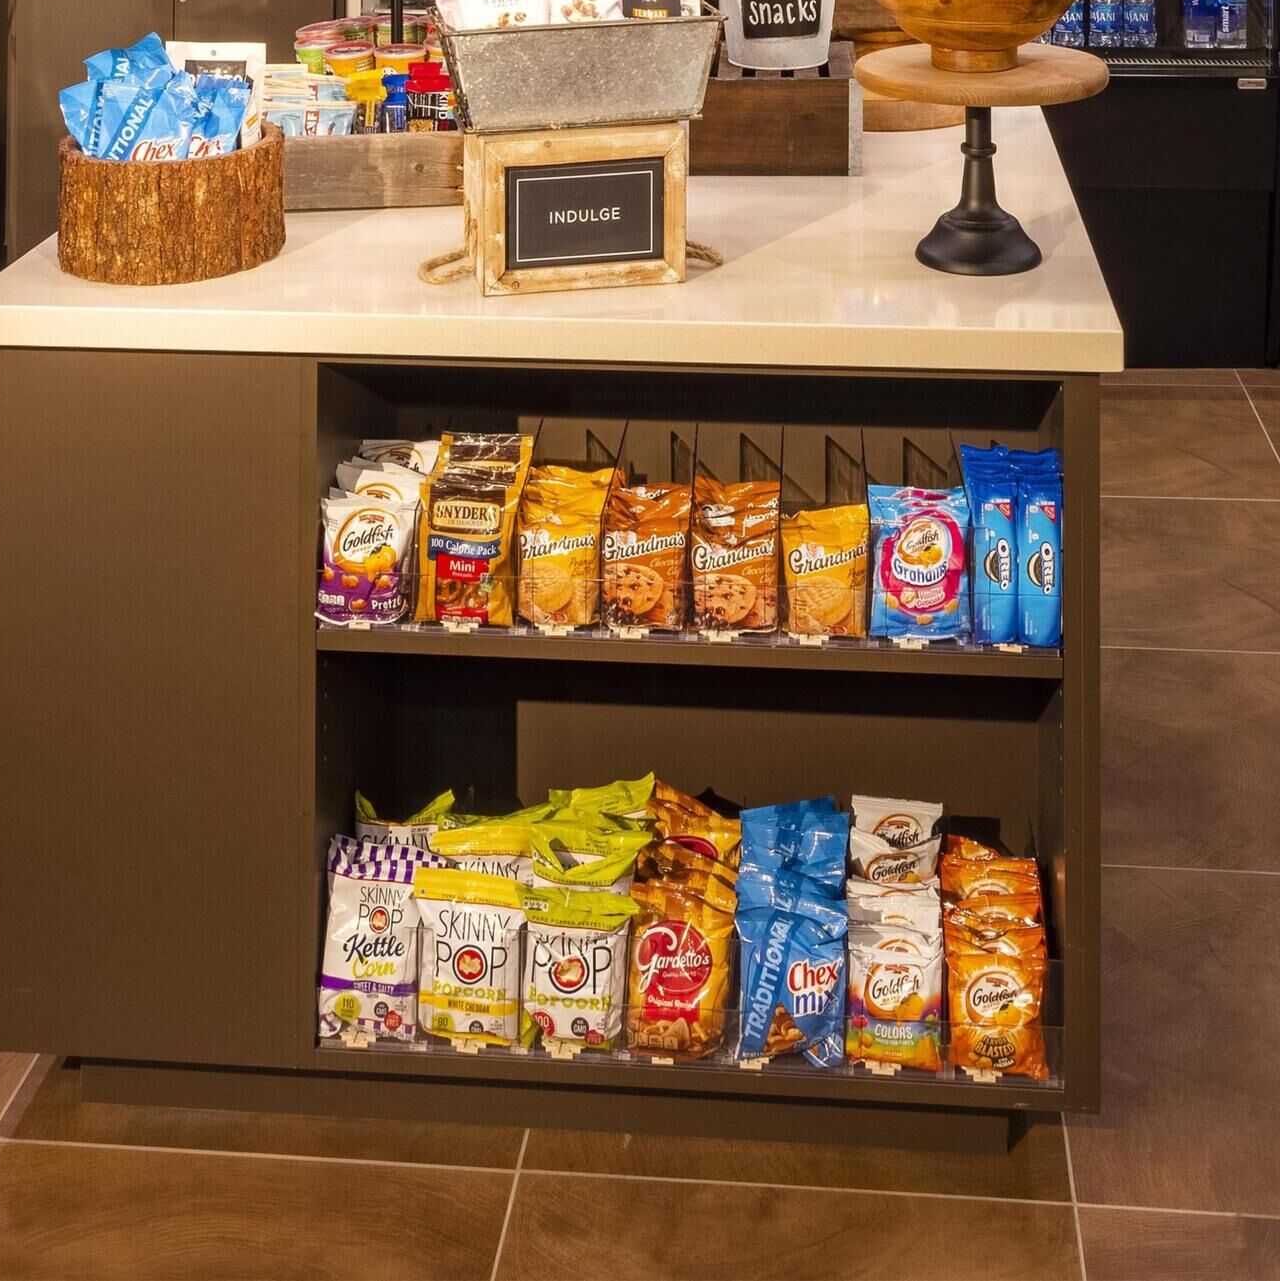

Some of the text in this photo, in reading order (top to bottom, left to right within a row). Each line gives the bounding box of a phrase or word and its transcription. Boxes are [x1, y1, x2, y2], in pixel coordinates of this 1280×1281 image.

[1221, 5, 1230, 33] smart
[439, 93, 449, 120] KIND
[131, 140, 175, 161] Chex
[549, 207, 621, 224] INDULGE
[342, 524, 395, 552] Goldfish
[430, 538, 444, 548] 100
[477, 544, 497, 556] Pack
[604, 531, 686, 561] Grandma's
[449, 560, 476, 572] Mini
[692, 539, 775, 571] Grandma's
[997, 538, 1010, 591] OREO
[1040, 541, 1054, 595] OREO
[871, 859, 918, 881] Goldfish
[360, 884, 406, 910] SKINNY
[357, 904, 404, 935] POP
[435, 909, 512, 943] SKINNY
[343, 933, 405, 964] Kettle
[637, 926, 711, 993] Gardetto's
[352, 955, 396, 978] Corn
[435, 940, 508, 987] POP
[433, 980, 506, 999] POPCORN
[788, 962, 839, 993] Chex
[342, 998, 355, 1009] 110
[447, 998, 490, 1013] WHITE CHEDDAR
[874, 1023, 913, 1039] COLORS
[974, 1041, 1015, 1058] BLASTED
